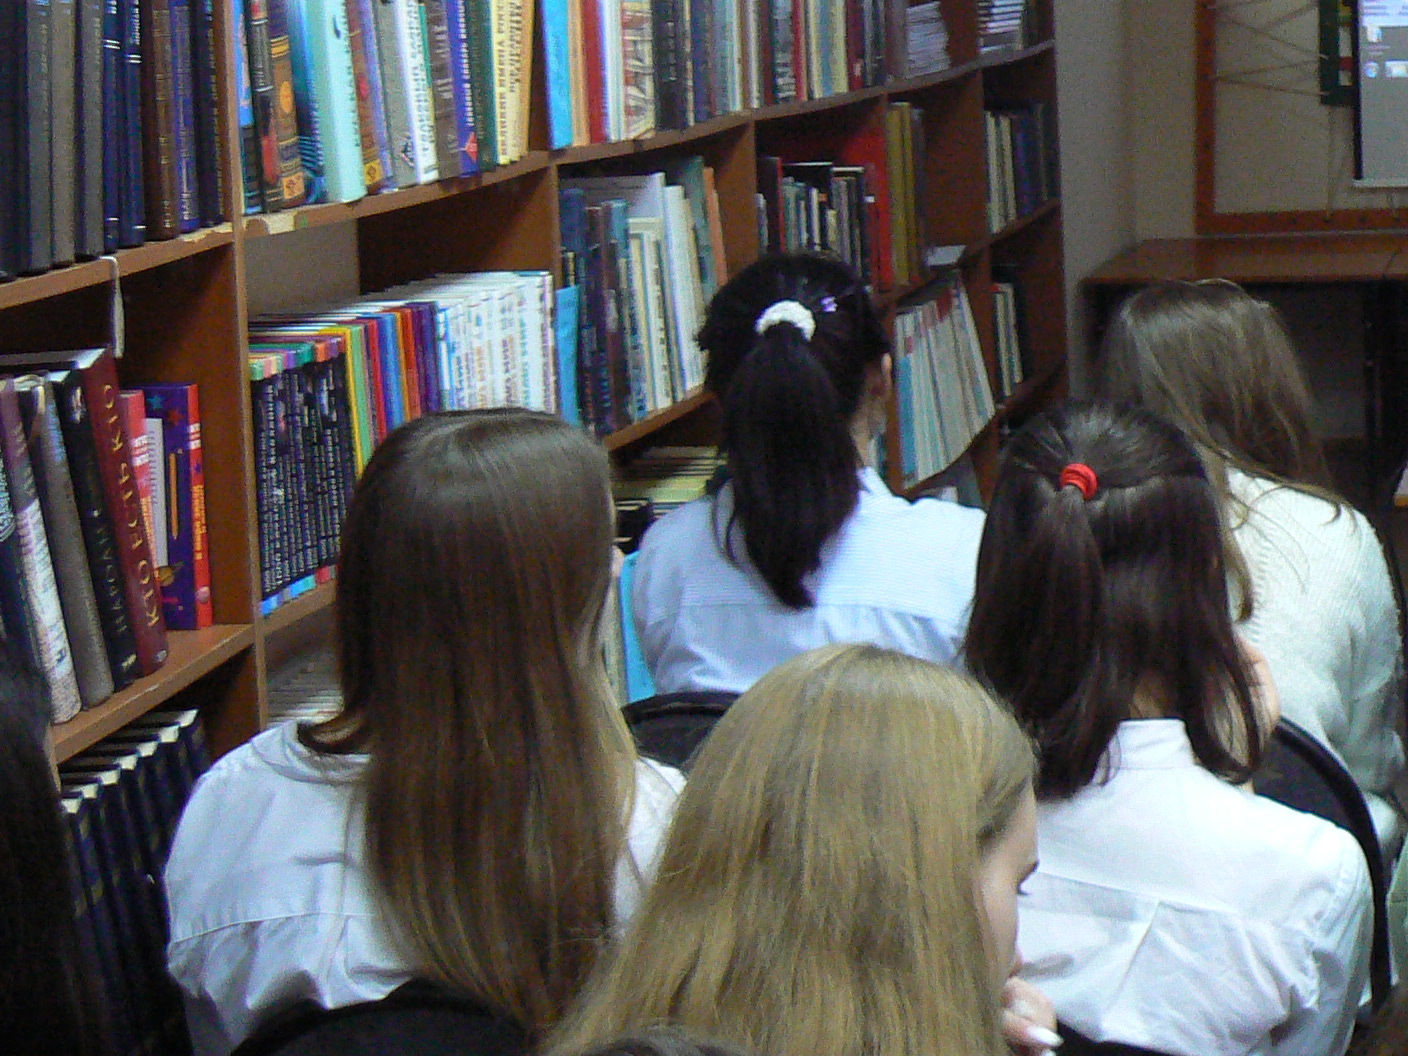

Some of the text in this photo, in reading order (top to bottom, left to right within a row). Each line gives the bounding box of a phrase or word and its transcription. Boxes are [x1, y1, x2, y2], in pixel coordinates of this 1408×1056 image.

[103, 384, 124, 452] КТО
[118, 462, 144, 551] ЕСТЬ
[138, 559, 160, 627] КТО
